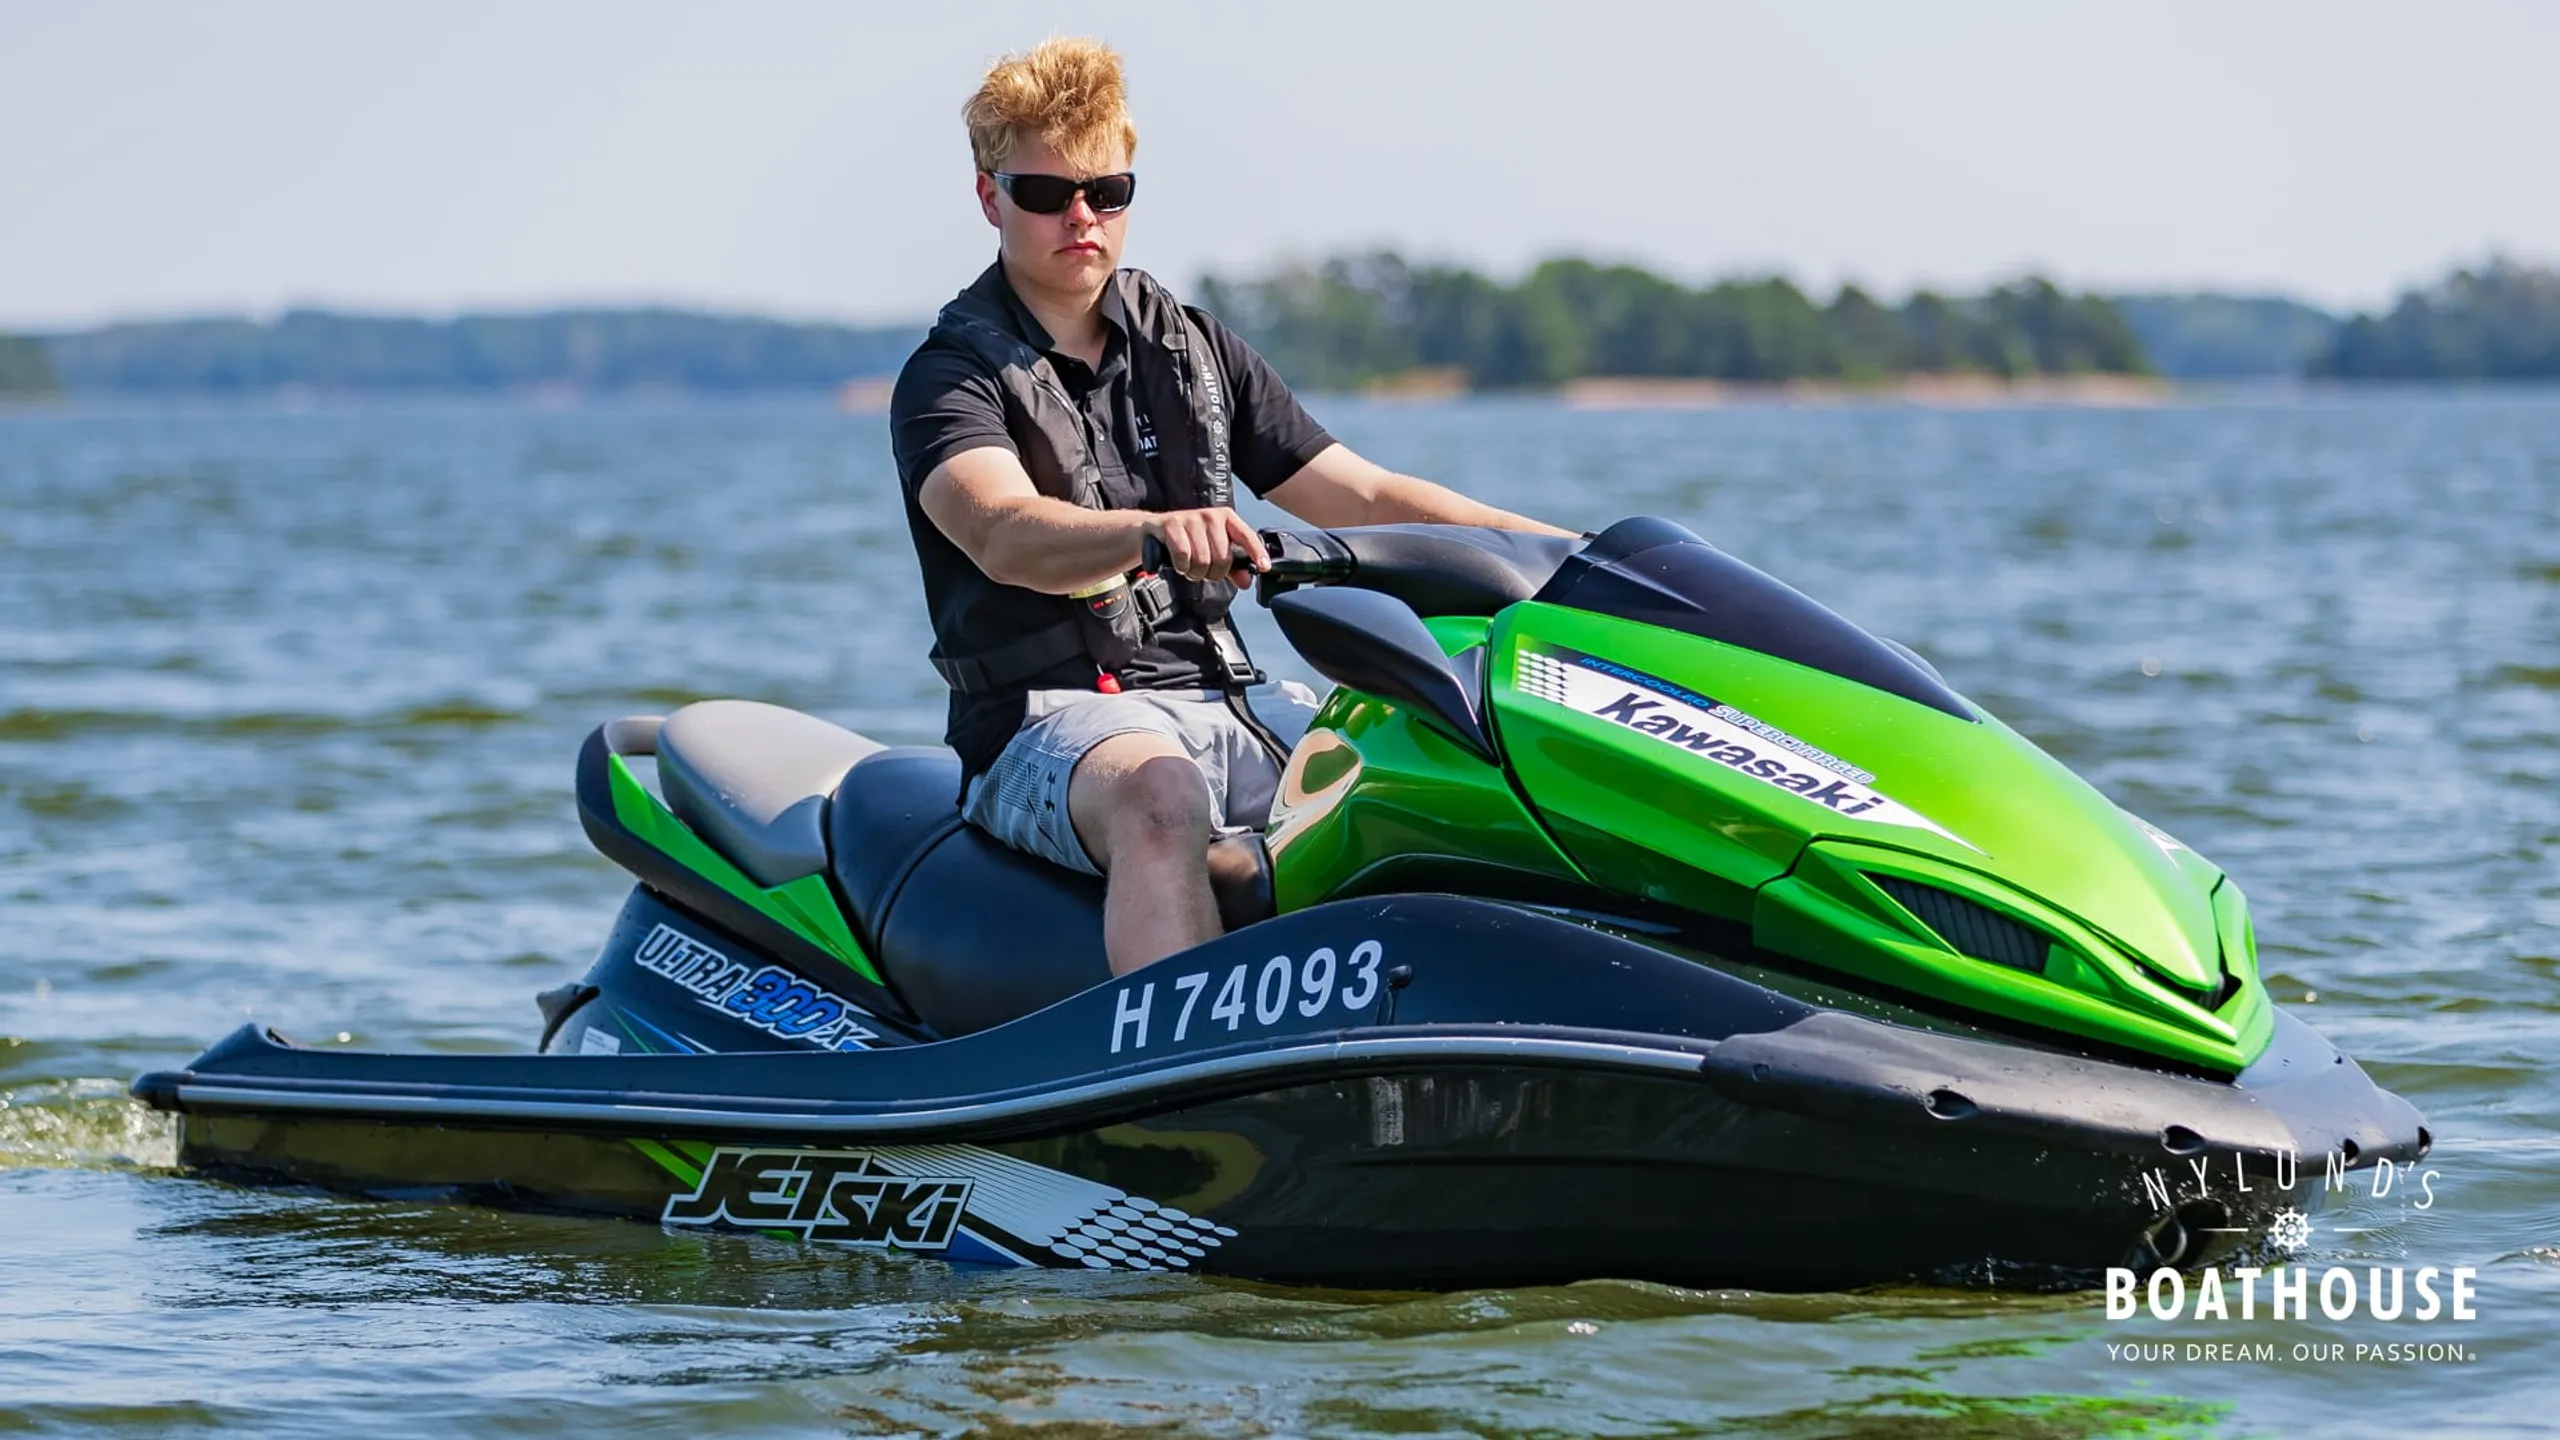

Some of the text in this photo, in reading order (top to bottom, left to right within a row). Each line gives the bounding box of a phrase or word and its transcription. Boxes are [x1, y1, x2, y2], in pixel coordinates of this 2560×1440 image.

[1580, 657, 1877, 785] INTERCOOLED SUPERCHARGED
[1593, 691, 1885, 815] Kawasaki
[634, 922, 751, 1003] ULTRA
[1110, 939, 1383, 1054] H 74093
